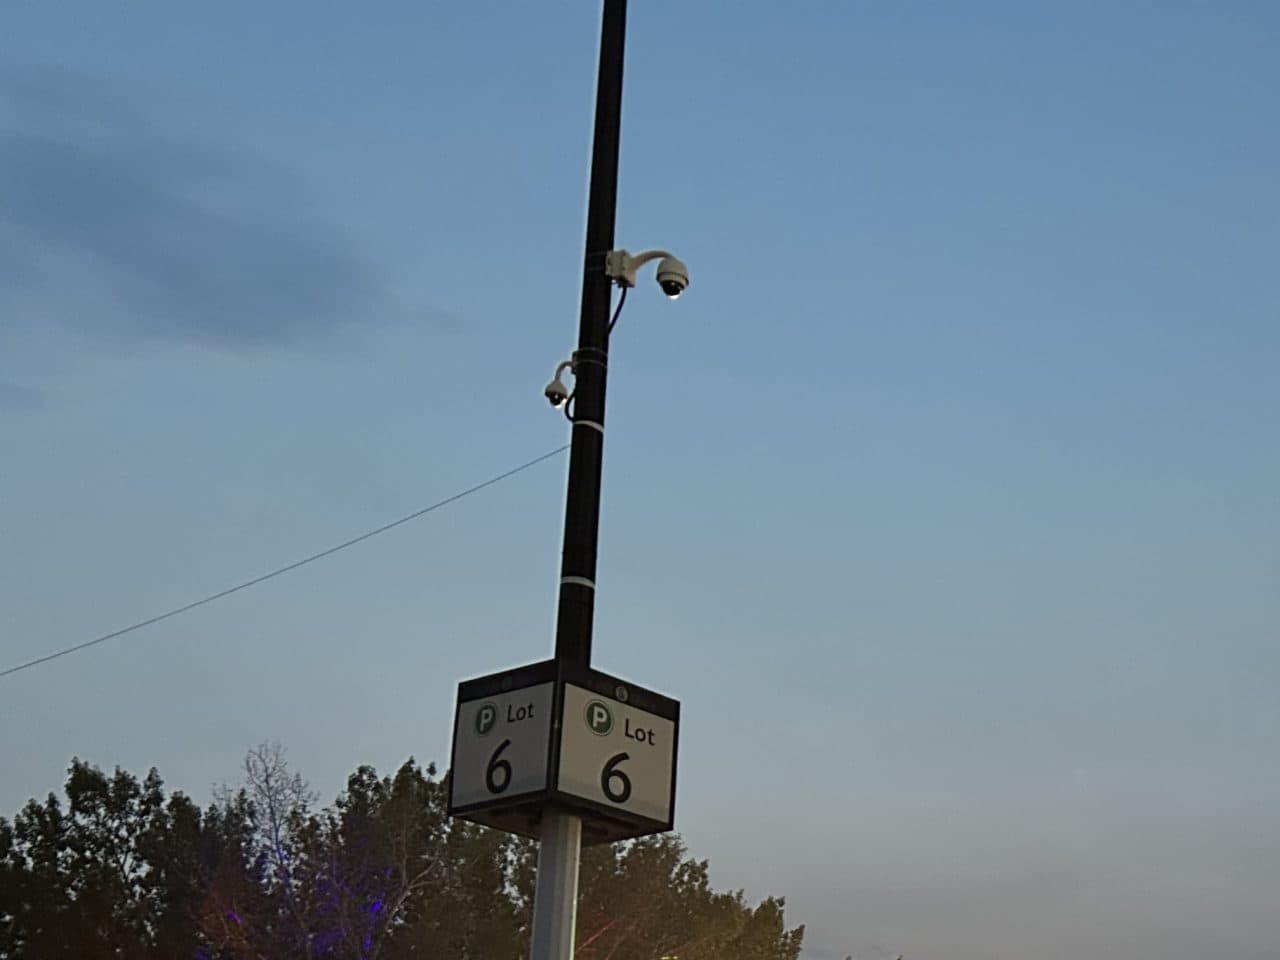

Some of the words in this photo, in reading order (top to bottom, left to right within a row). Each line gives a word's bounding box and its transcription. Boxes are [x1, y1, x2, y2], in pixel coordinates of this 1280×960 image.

[506, 704, 534, 723] Lot
[624, 719, 655, 746] Lot
[485, 739, 512, 794] 6
[601, 752, 631, 803] 6
